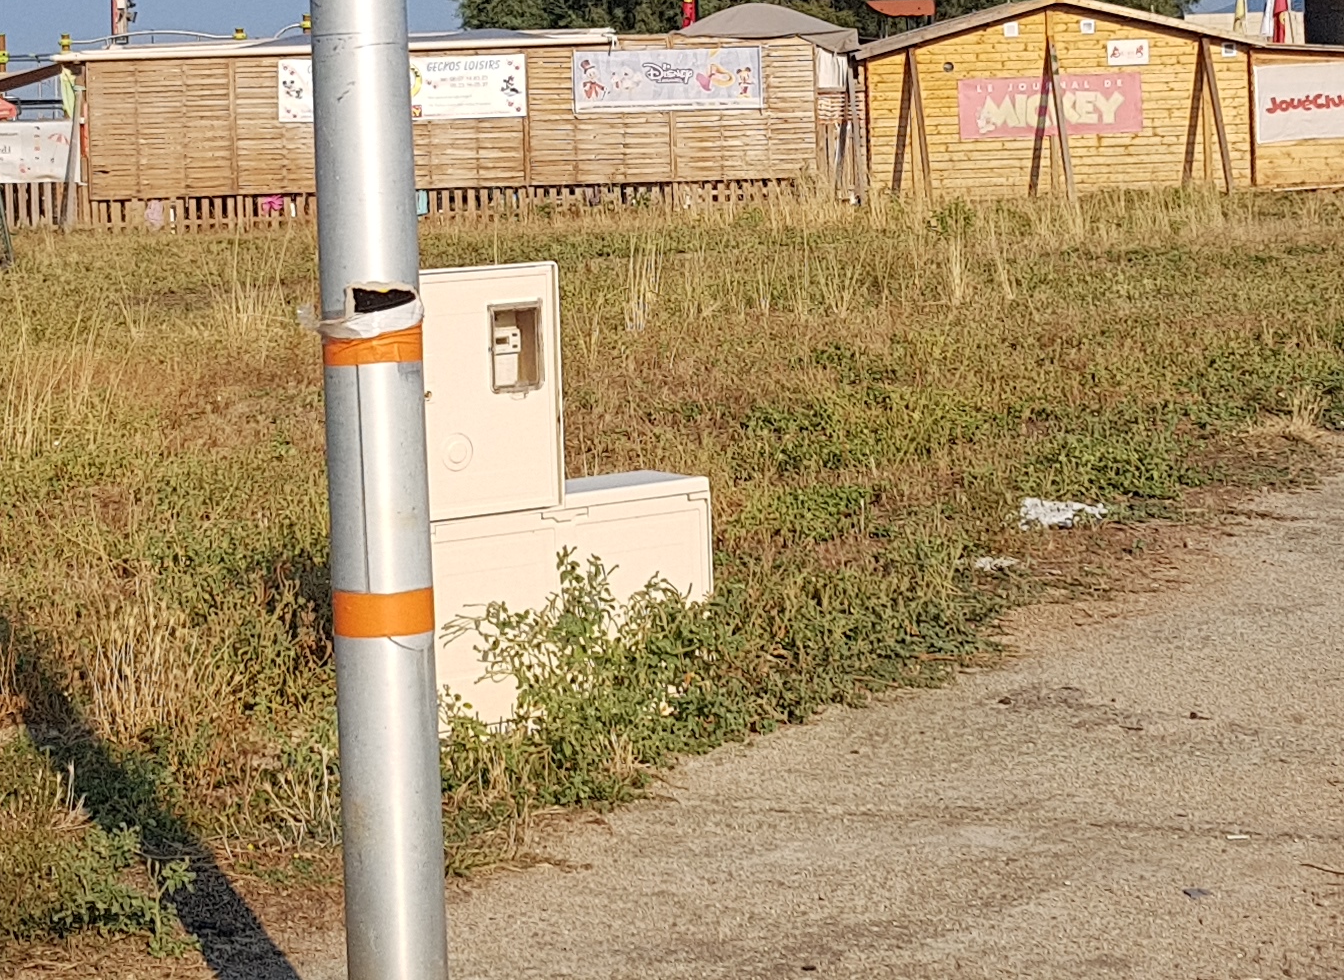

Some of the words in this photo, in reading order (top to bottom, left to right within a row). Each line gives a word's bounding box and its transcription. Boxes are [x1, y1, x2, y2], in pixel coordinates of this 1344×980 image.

[464, 59, 501, 71] LOISIRS
[977, 83, 994, 92] LE
[1104, 78, 1123, 88] DE
[979, 90, 1125, 127] MICKEY
